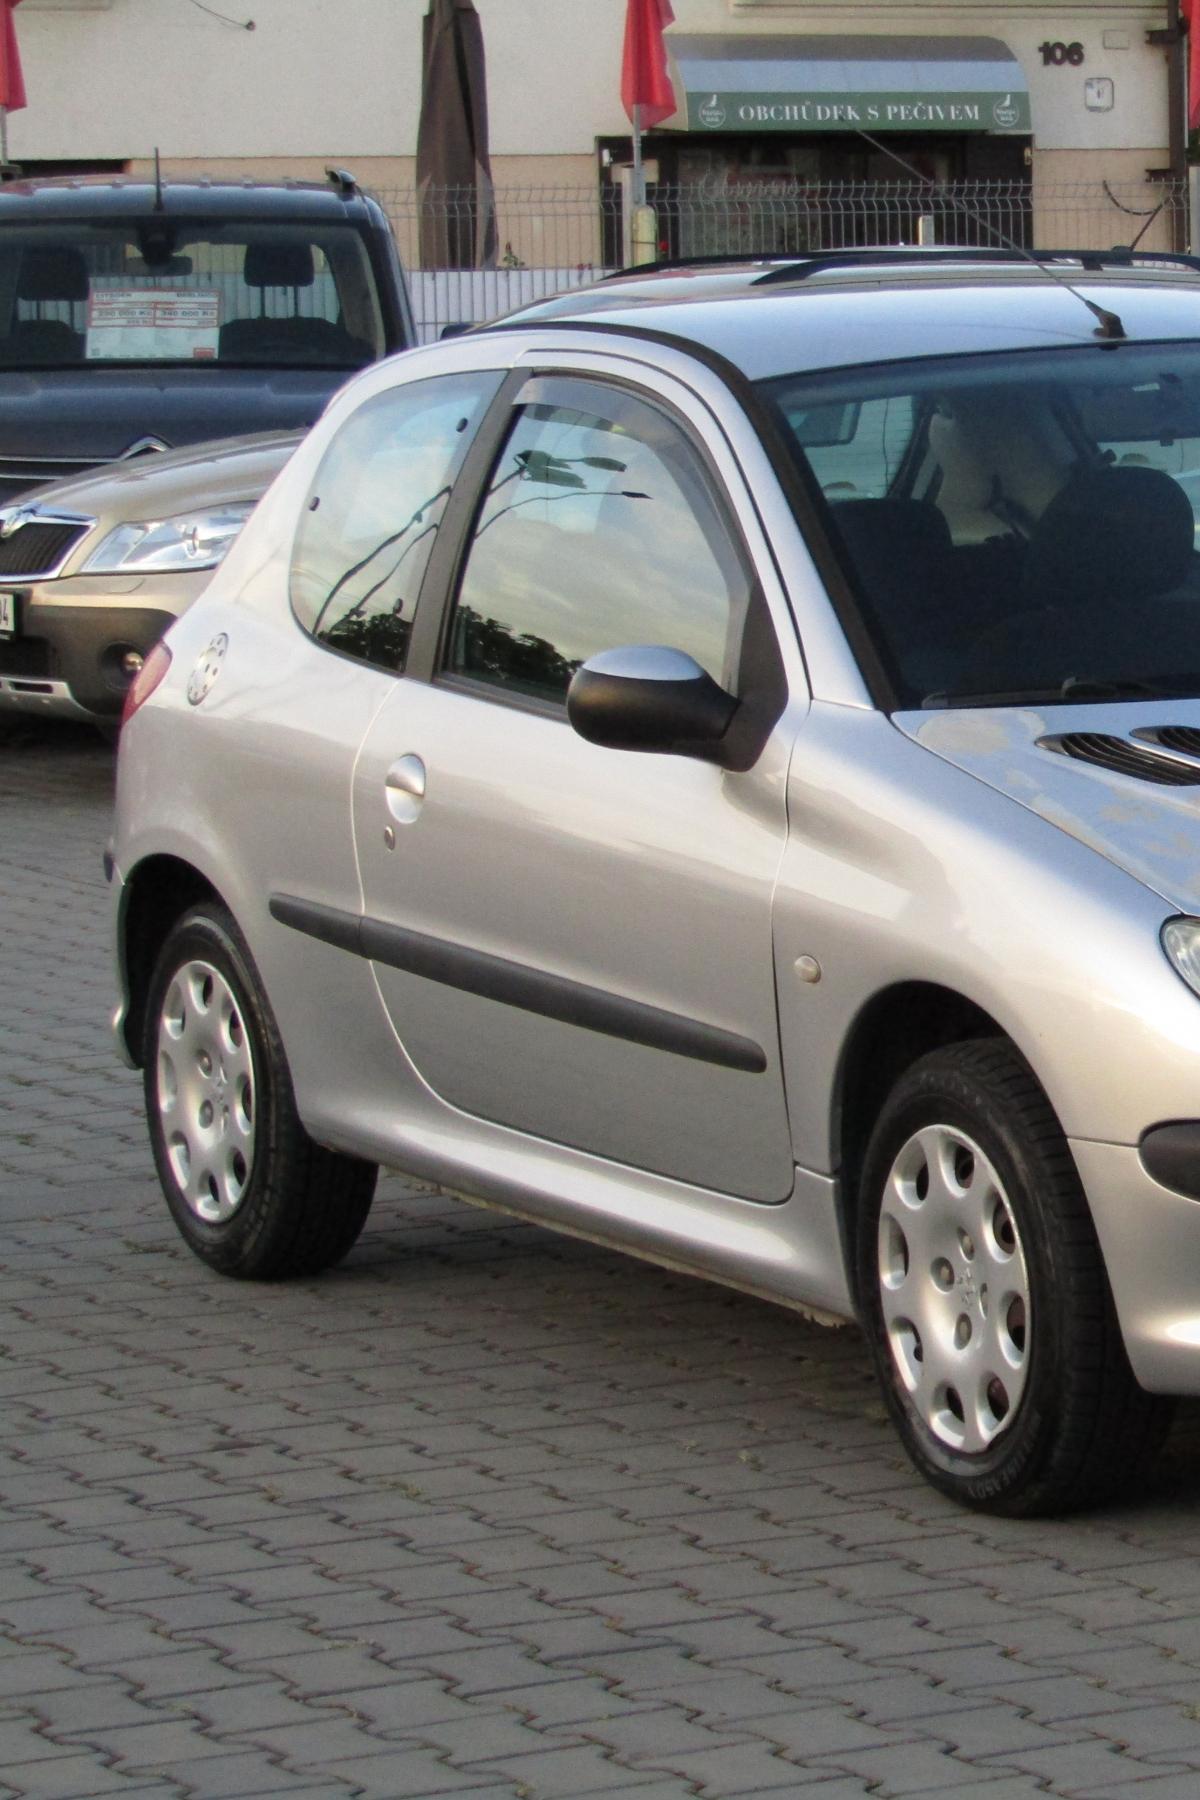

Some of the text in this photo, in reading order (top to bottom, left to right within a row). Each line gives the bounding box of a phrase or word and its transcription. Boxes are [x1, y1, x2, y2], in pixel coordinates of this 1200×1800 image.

[1038, 41, 1085, 66] 106
[738, 101, 861, 121] OBCHŮDEK
[867, 105, 879, 121] S
[887, 101, 980, 121] PEČIVEM
